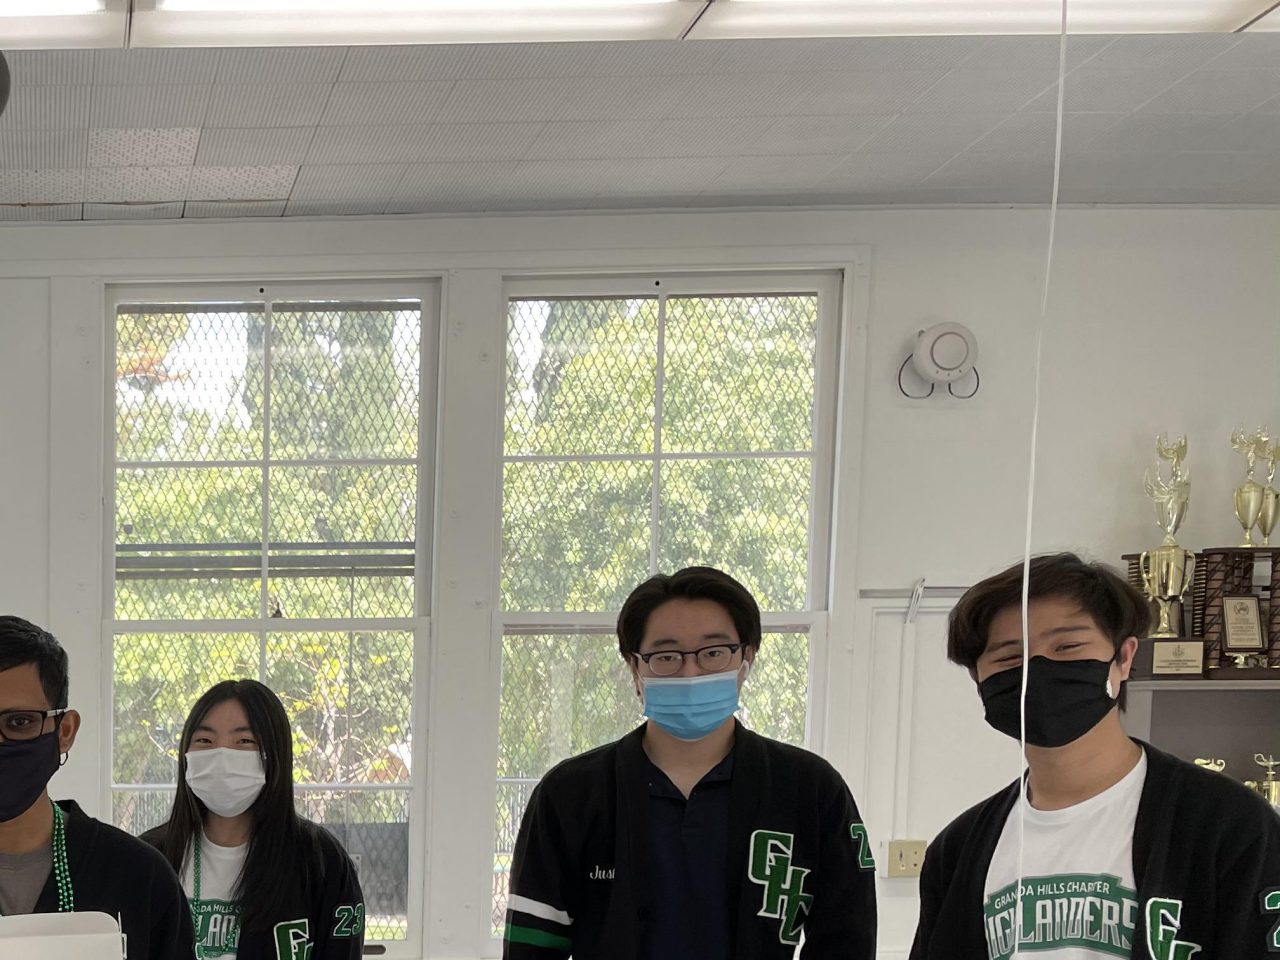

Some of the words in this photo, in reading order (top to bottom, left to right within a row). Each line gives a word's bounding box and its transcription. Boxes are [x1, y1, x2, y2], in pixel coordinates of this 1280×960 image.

[994, 884, 1034, 910] GRANDA
[1037, 882, 1065, 896] HILLS
[1066, 881, 1111, 895] CHARTER
[333, 903, 366, 937] 23
[984, 897, 1139, 960] IGHLANDERS
